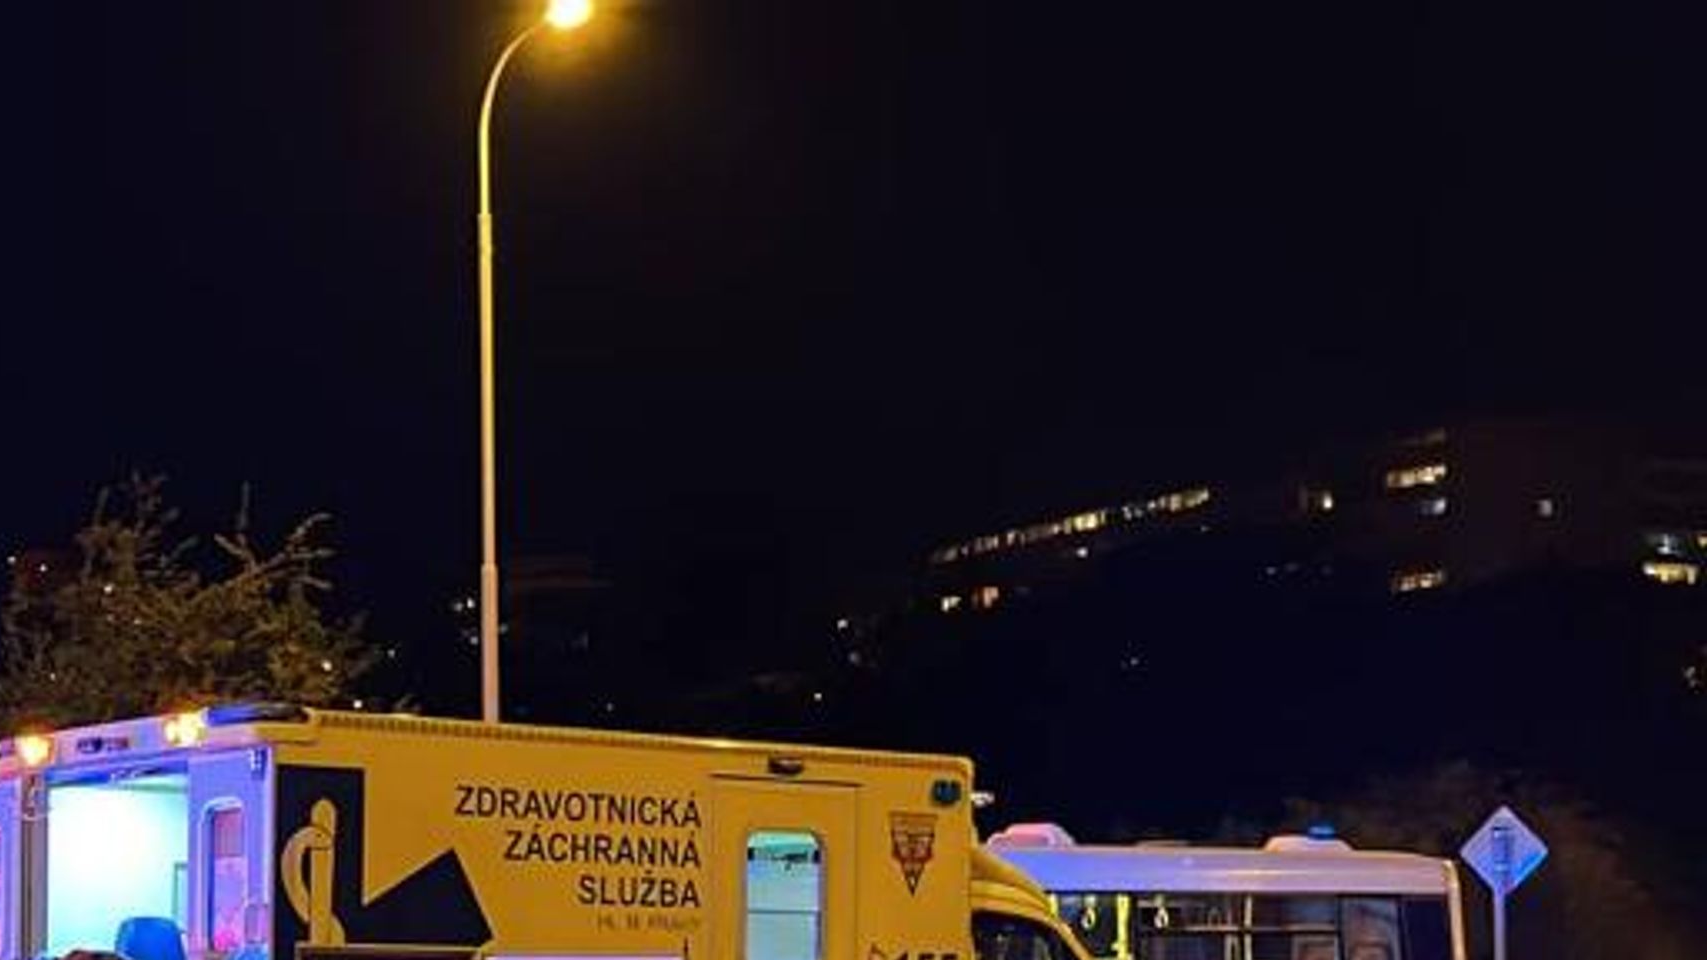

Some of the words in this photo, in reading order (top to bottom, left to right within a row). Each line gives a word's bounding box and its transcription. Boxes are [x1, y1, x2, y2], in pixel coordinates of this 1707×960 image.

[454, 784, 702, 828] ZDRAVOTNICKÁ
[503, 824, 702, 868] ZÁCHRANNÁ
[577, 869, 701, 908] SLUŽBA
